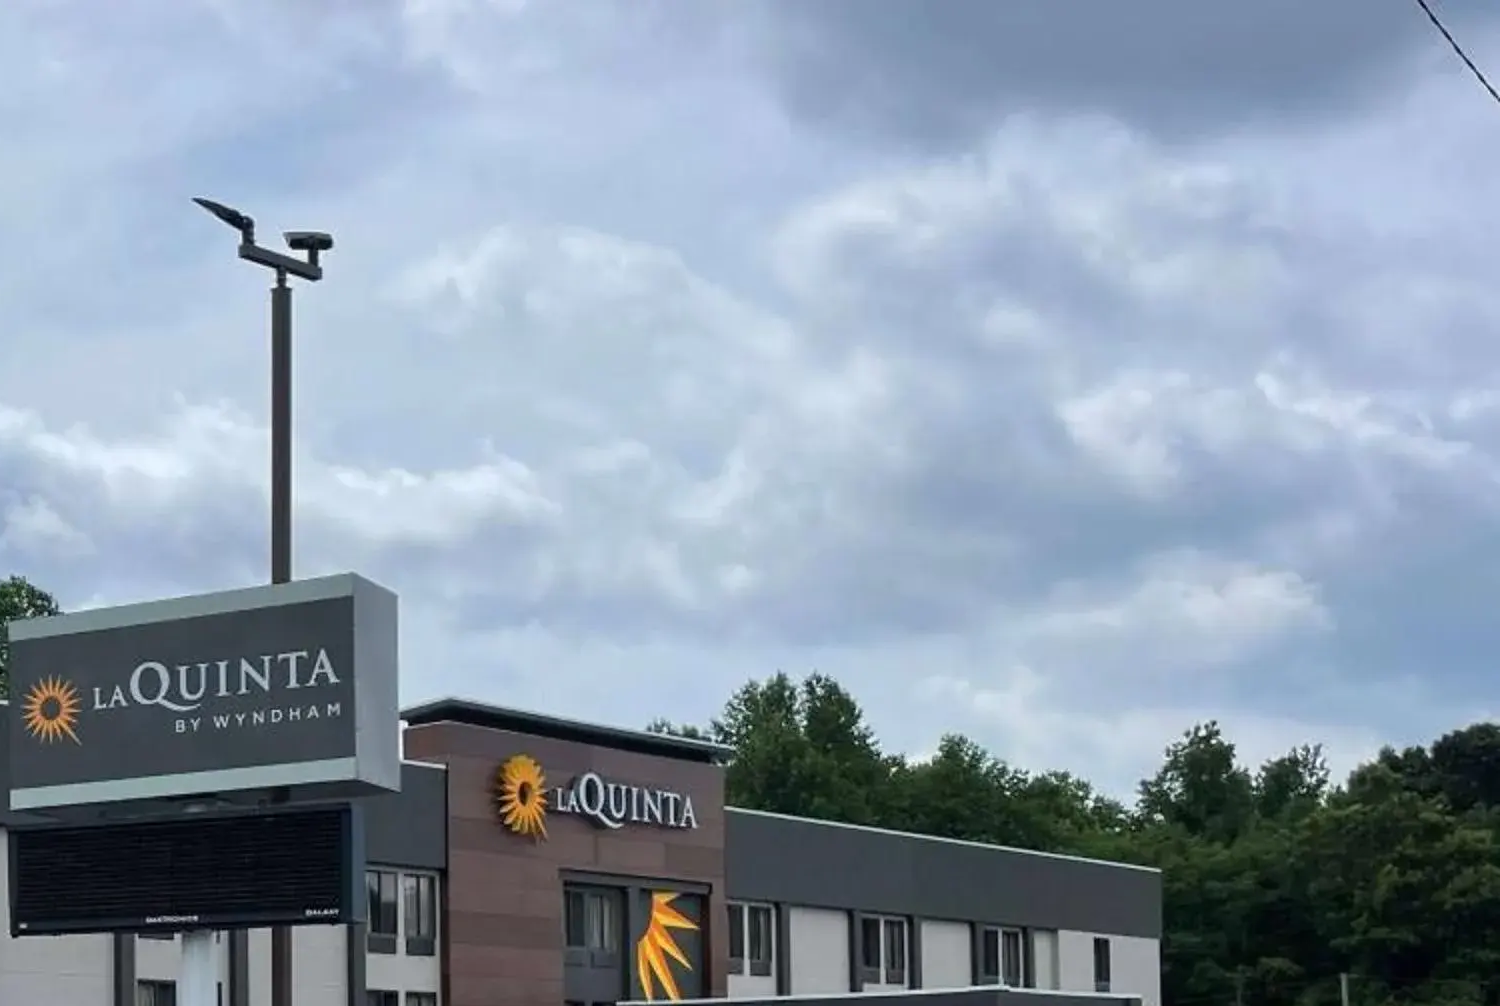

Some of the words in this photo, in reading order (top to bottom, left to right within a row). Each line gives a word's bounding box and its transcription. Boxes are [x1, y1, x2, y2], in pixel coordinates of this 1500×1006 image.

[129, 648, 341, 712] QUINTA
[175, 718, 201, 733] BY
[213, 703, 341, 729] WYNDHAM
[579, 772, 698, 829] QUINTA
